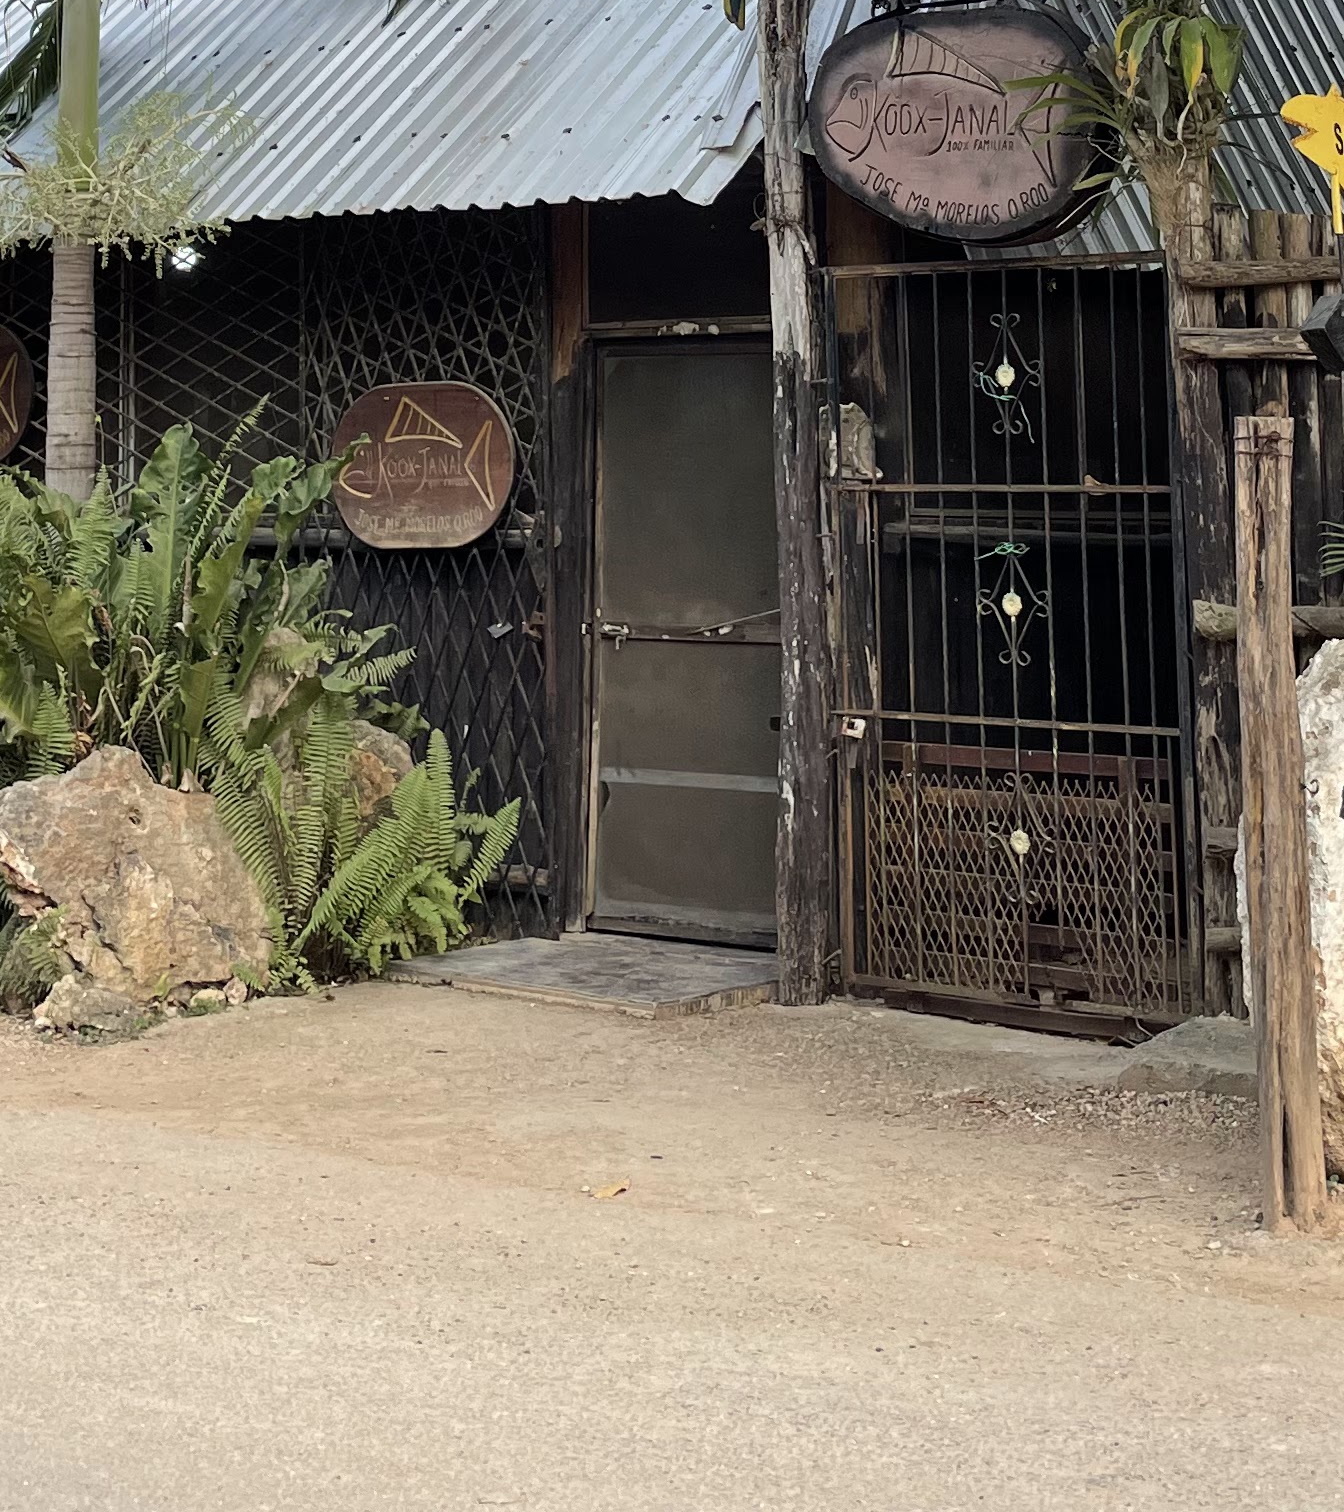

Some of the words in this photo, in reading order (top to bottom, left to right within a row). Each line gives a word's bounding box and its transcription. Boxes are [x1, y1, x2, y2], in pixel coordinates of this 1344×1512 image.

[972, 138, 1015, 152] FAMILIAR
[859, 163, 904, 204] JOSE
[934, 199, 1000, 226] MORELOS
